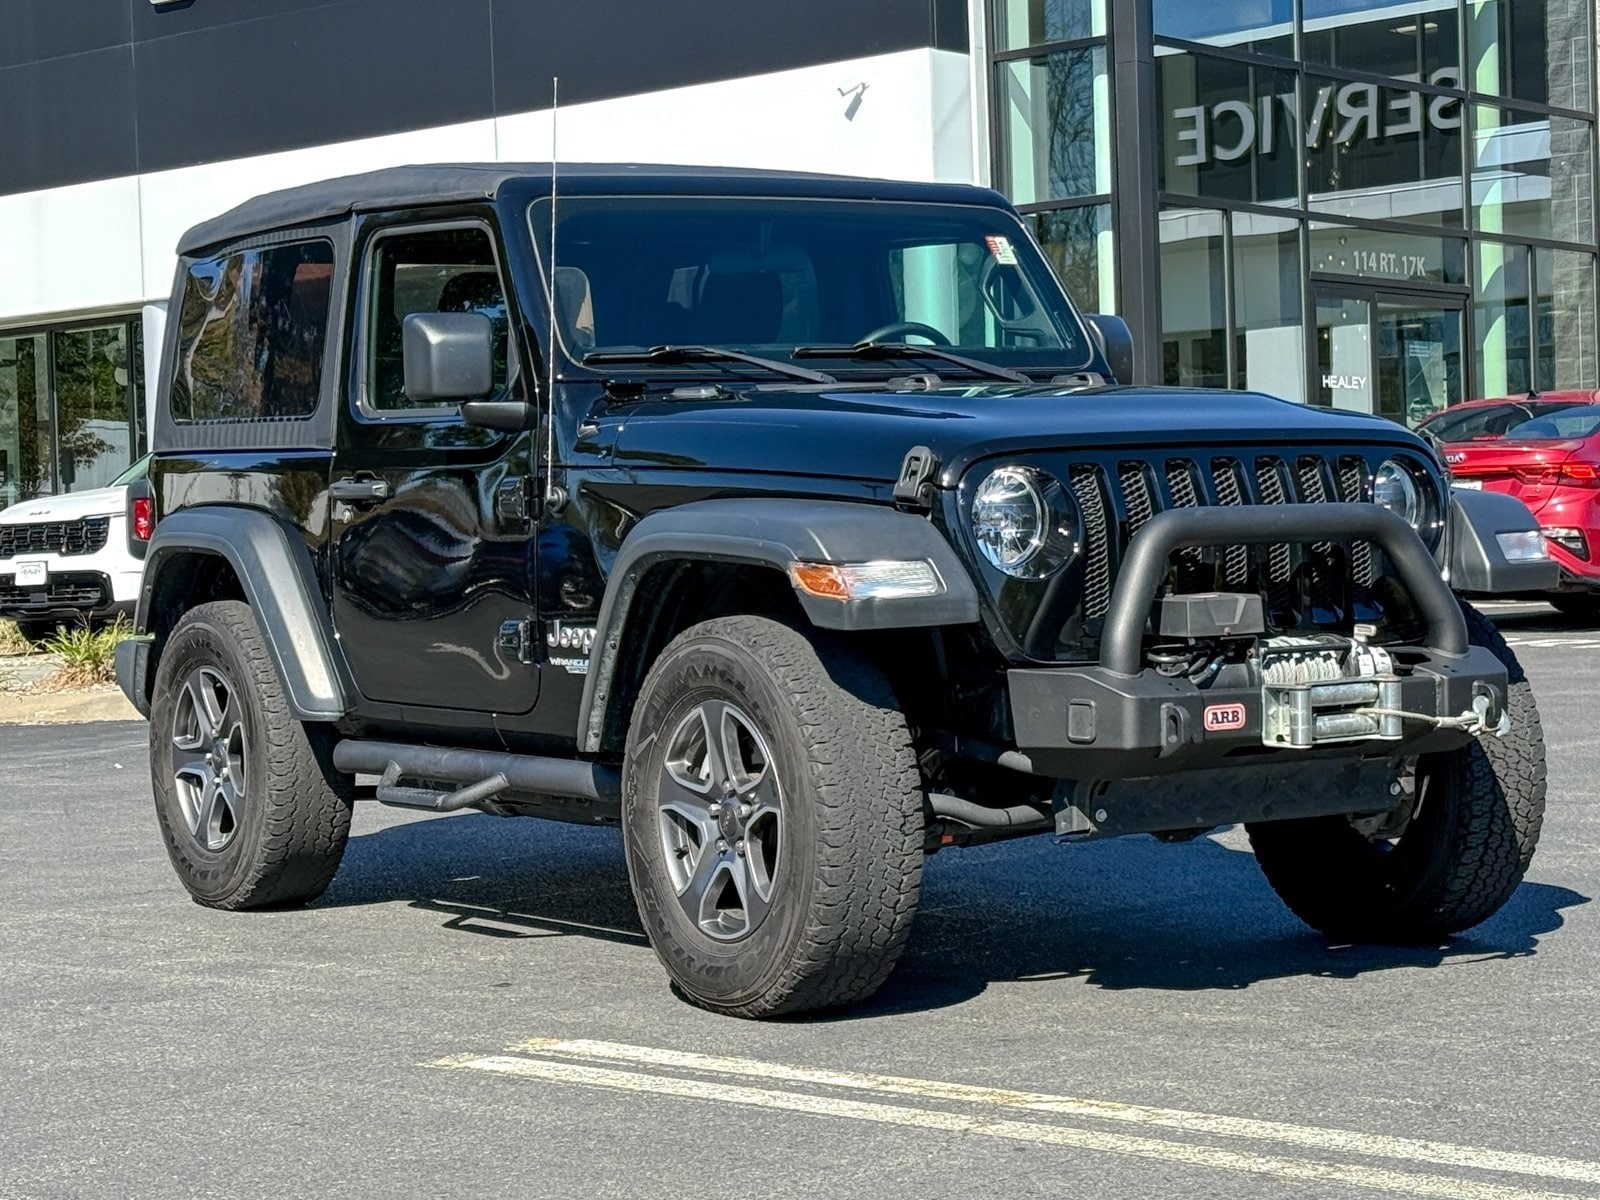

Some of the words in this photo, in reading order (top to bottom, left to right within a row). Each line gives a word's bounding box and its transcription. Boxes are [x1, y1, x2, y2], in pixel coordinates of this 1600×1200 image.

[1353, 250, 1377, 272] 114
[1380, 252, 1399, 274] RT.
[1401, 255, 1426, 277] 17K
[1322, 374, 1366, 389] HEALEY
[547, 619, 597, 655] Jeep
[1209, 709, 1239, 725] ARB
